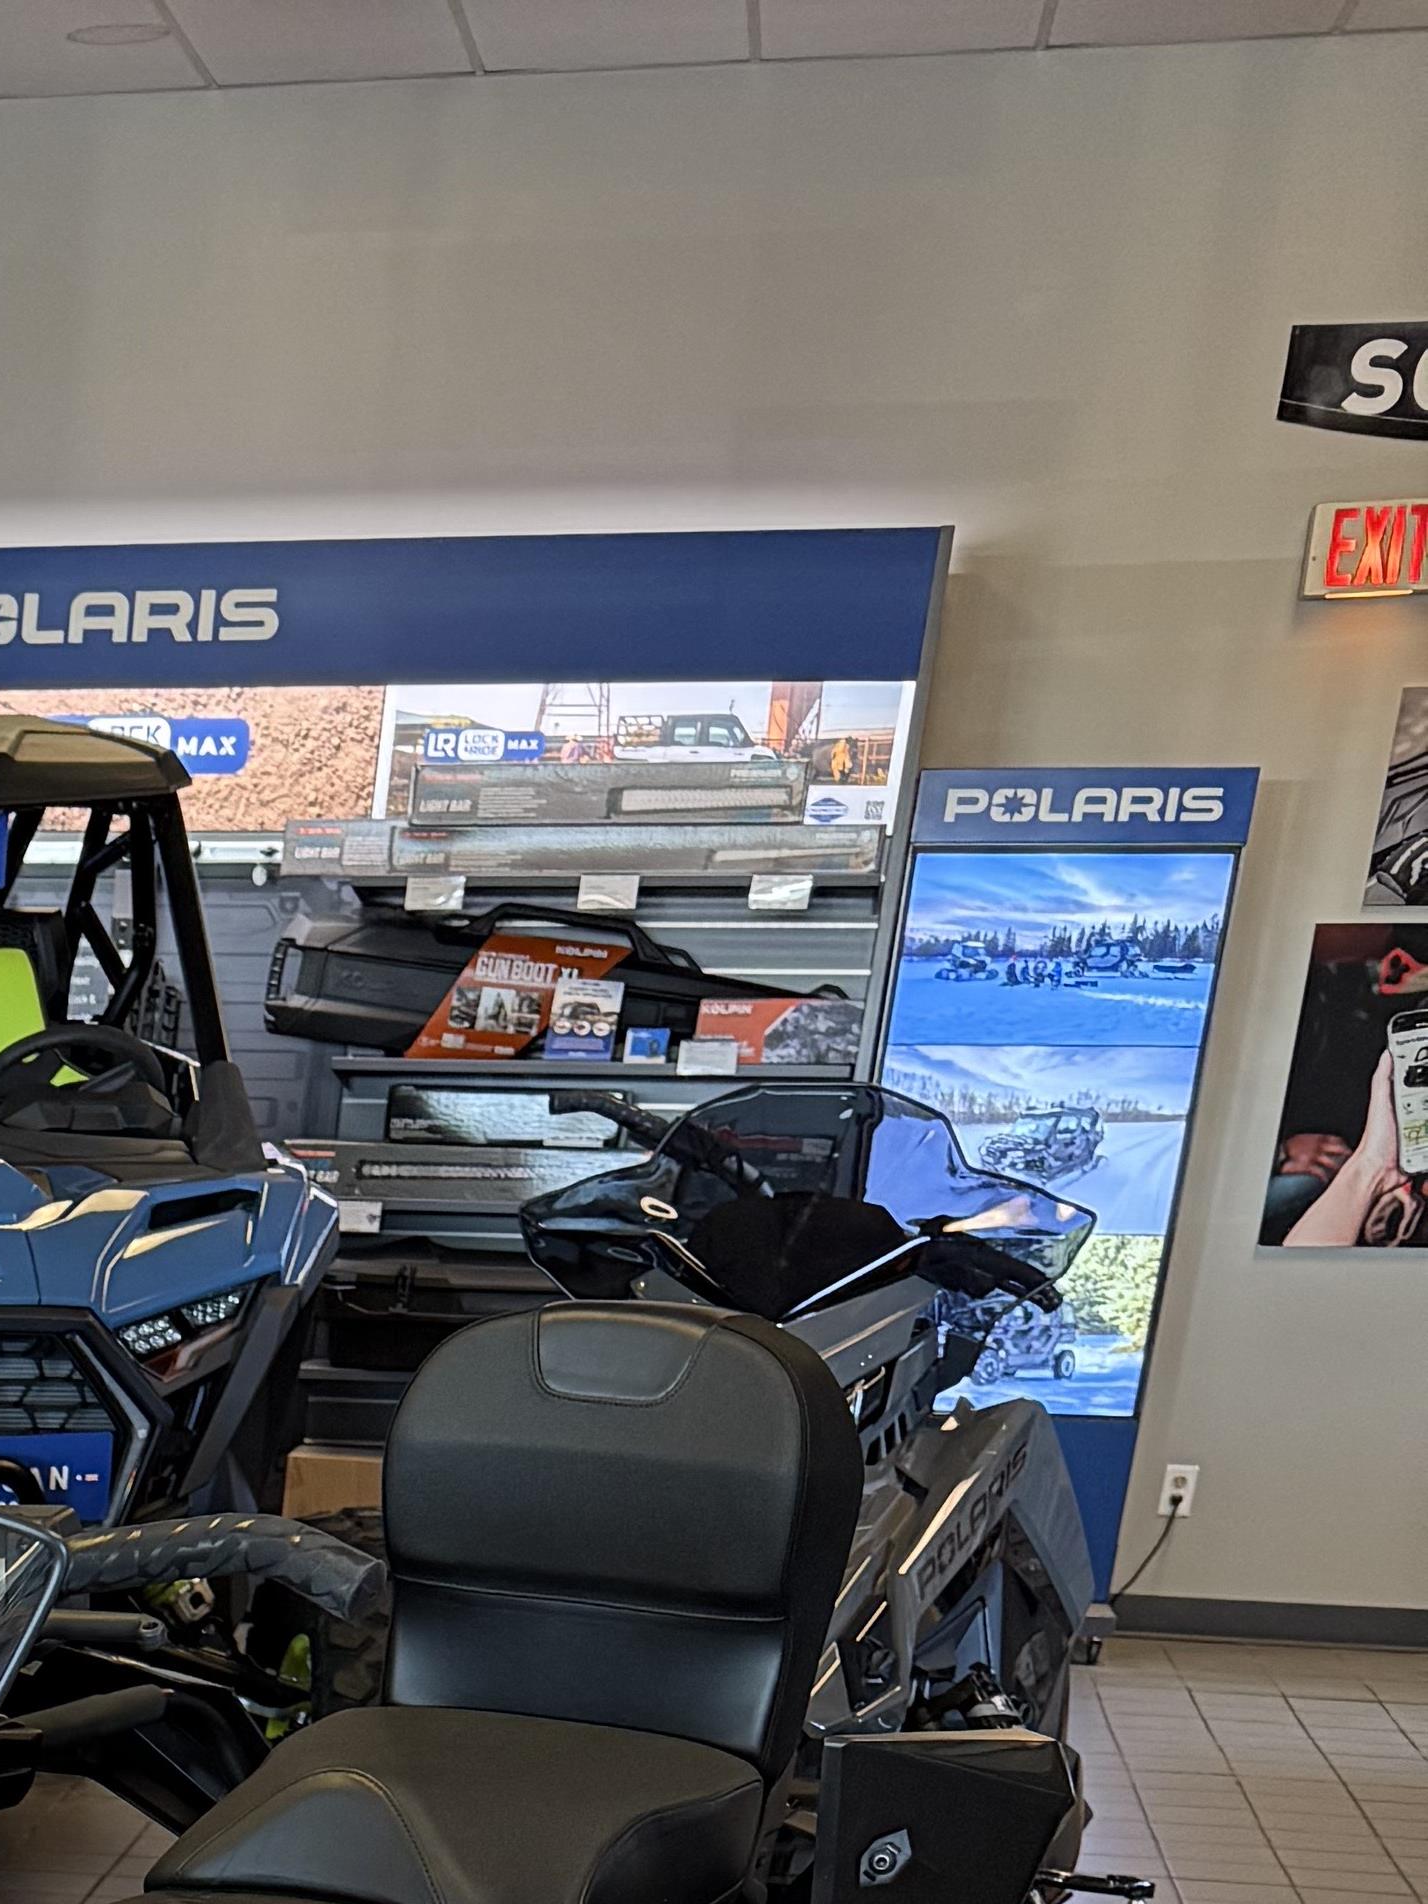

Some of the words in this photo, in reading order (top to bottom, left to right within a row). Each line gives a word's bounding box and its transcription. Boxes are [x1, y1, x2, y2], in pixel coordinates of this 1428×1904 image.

[1324, 503, 1428, 588] EXIT
[177, 735, 236, 757] MAX
[507, 739, 540, 750] MAX
[943, 785, 1225, 823] POLARIS
[475, 956, 510, 980] GUN
[511, 959, 559, 984] BOOT
[916, 1440, 1028, 1600] POLARIS
